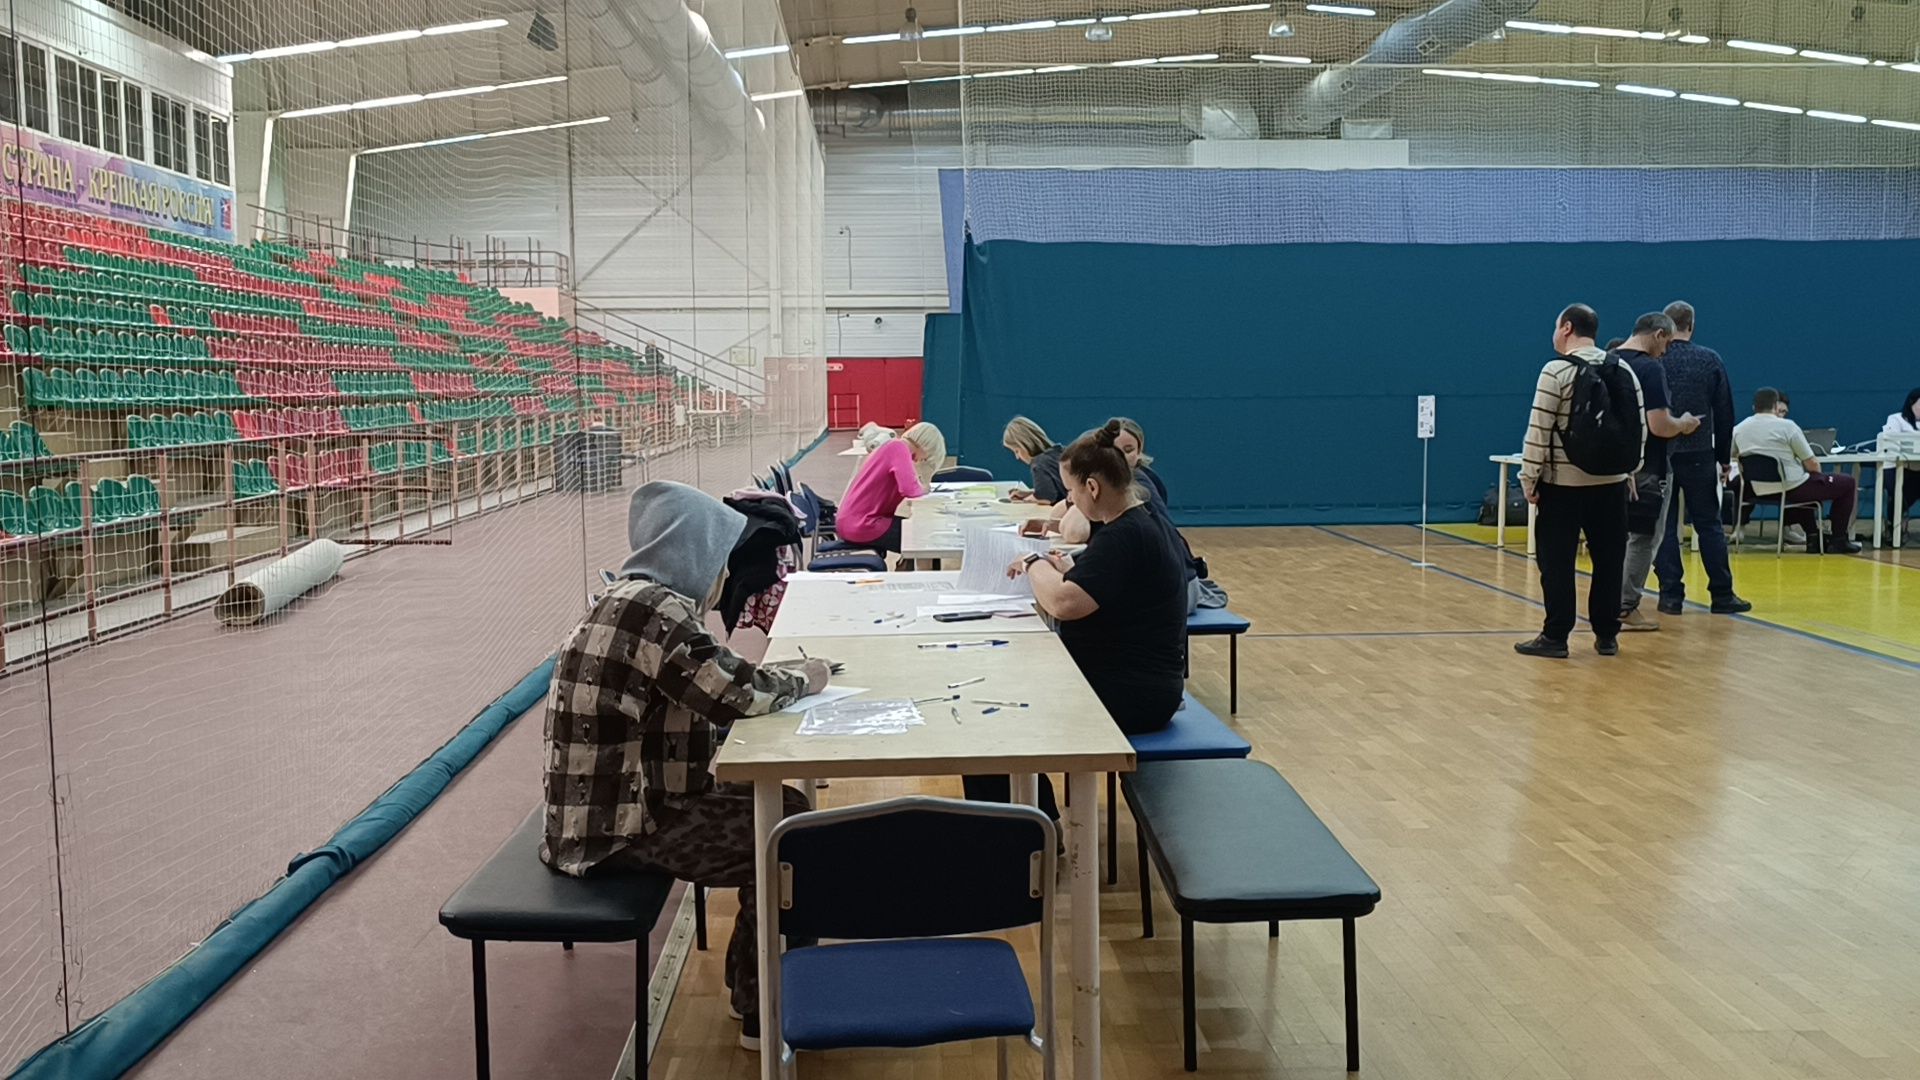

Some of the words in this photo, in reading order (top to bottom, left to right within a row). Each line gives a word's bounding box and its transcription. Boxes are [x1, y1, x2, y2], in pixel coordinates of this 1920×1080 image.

[2, 143, 76, 194] СТРАНА
[88, 165, 158, 212] КРЕПКАЯ
[162, 186, 214, 225] РОССИЯ
